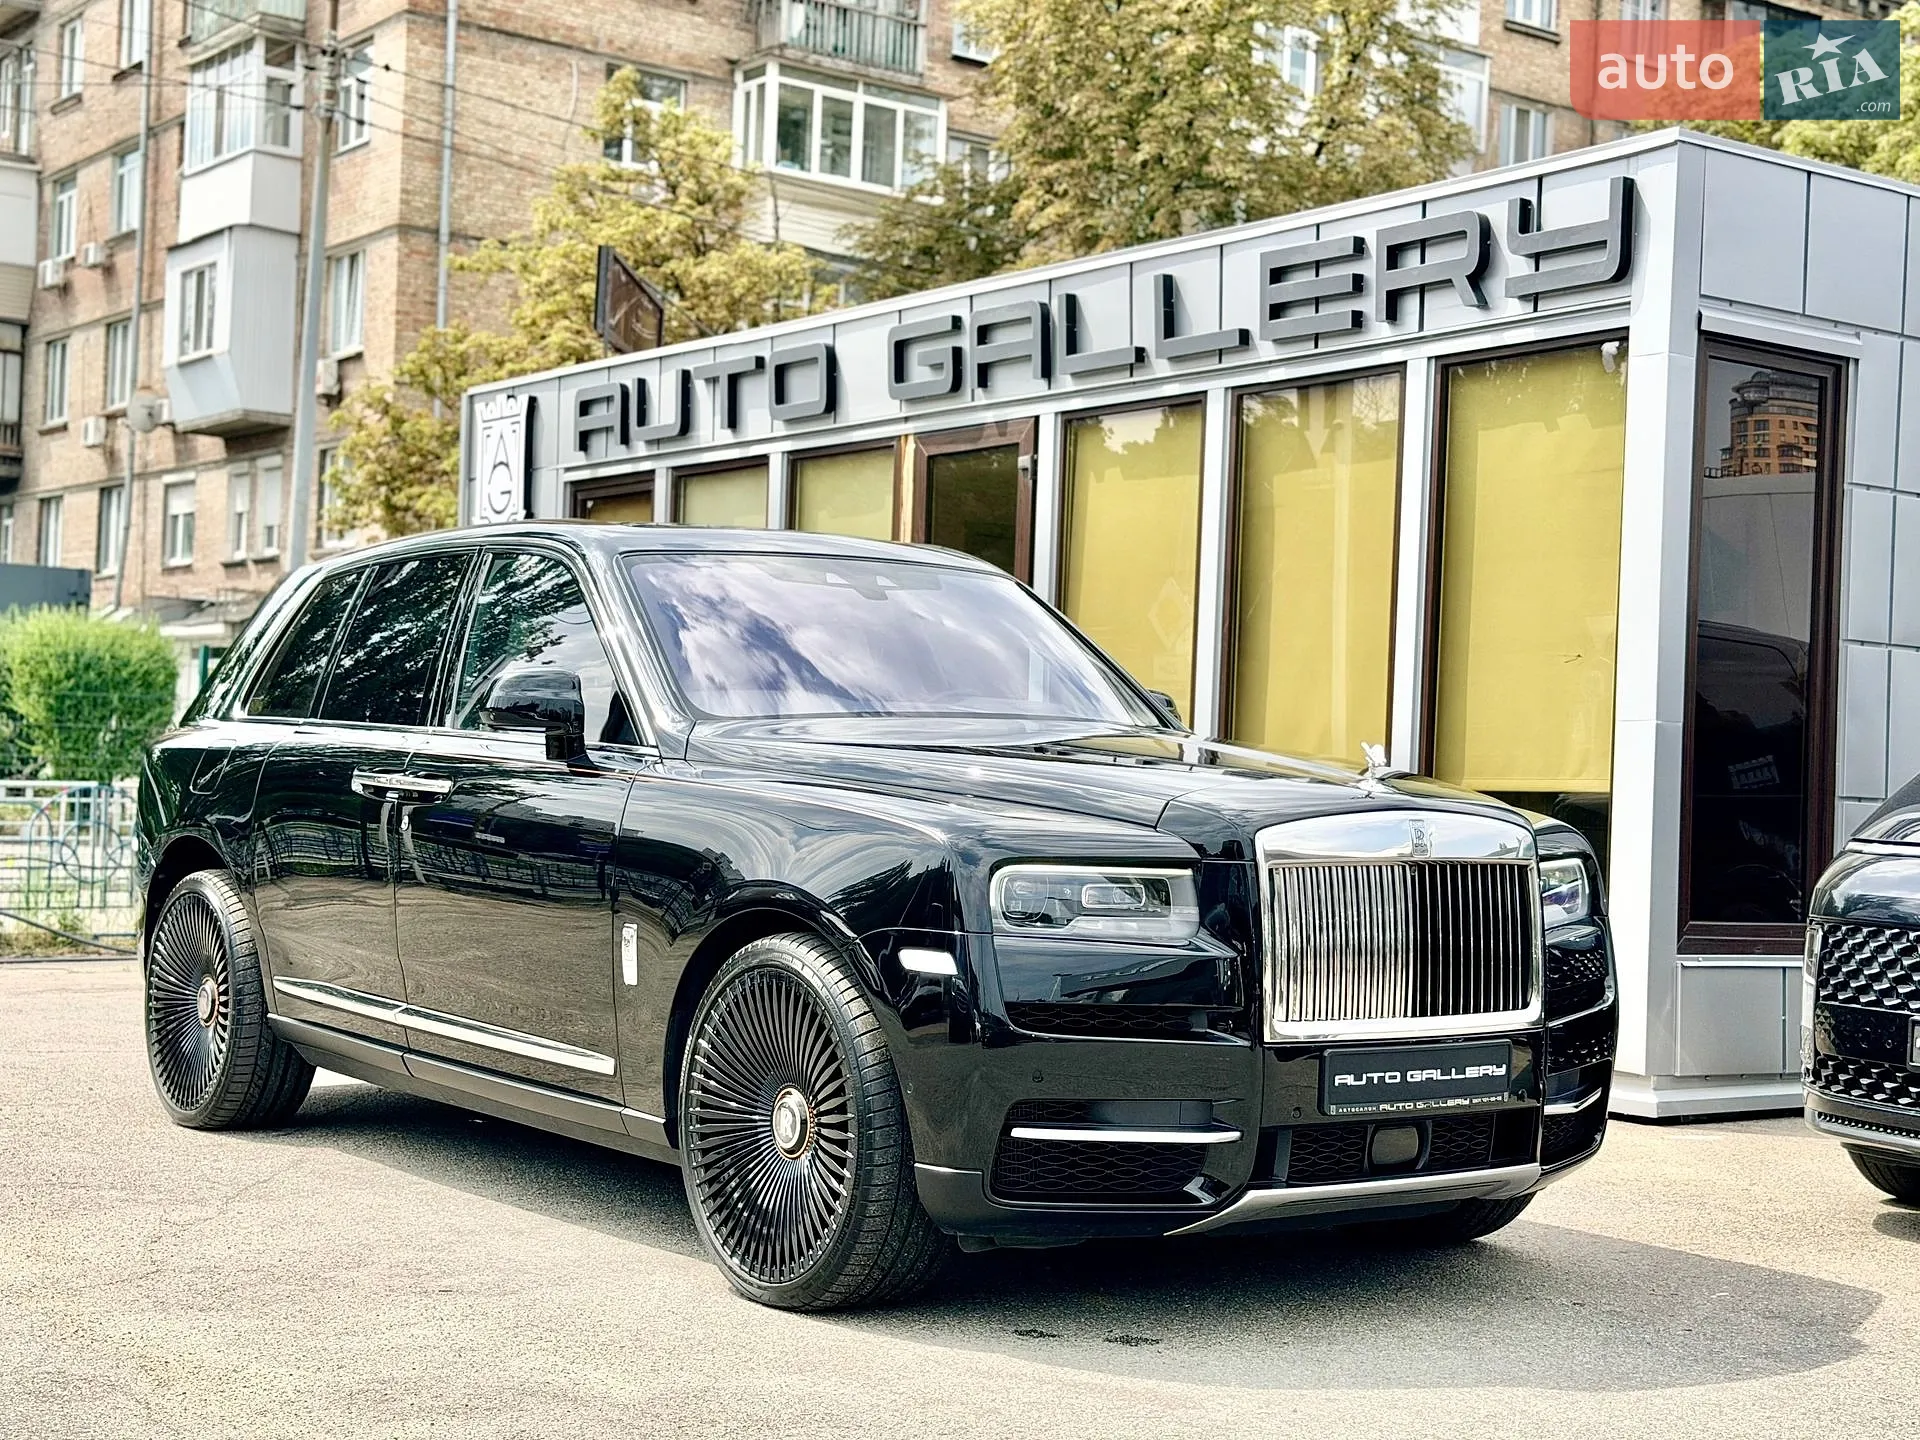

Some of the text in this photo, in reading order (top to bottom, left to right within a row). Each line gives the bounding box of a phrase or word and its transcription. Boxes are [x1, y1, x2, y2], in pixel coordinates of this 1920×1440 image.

[573, 175, 1639, 453] AUTO GALLERY
[1334, 1063, 1507, 1086] AUTO GALLERY
[1379, 1102, 1414, 1111] AUTO
